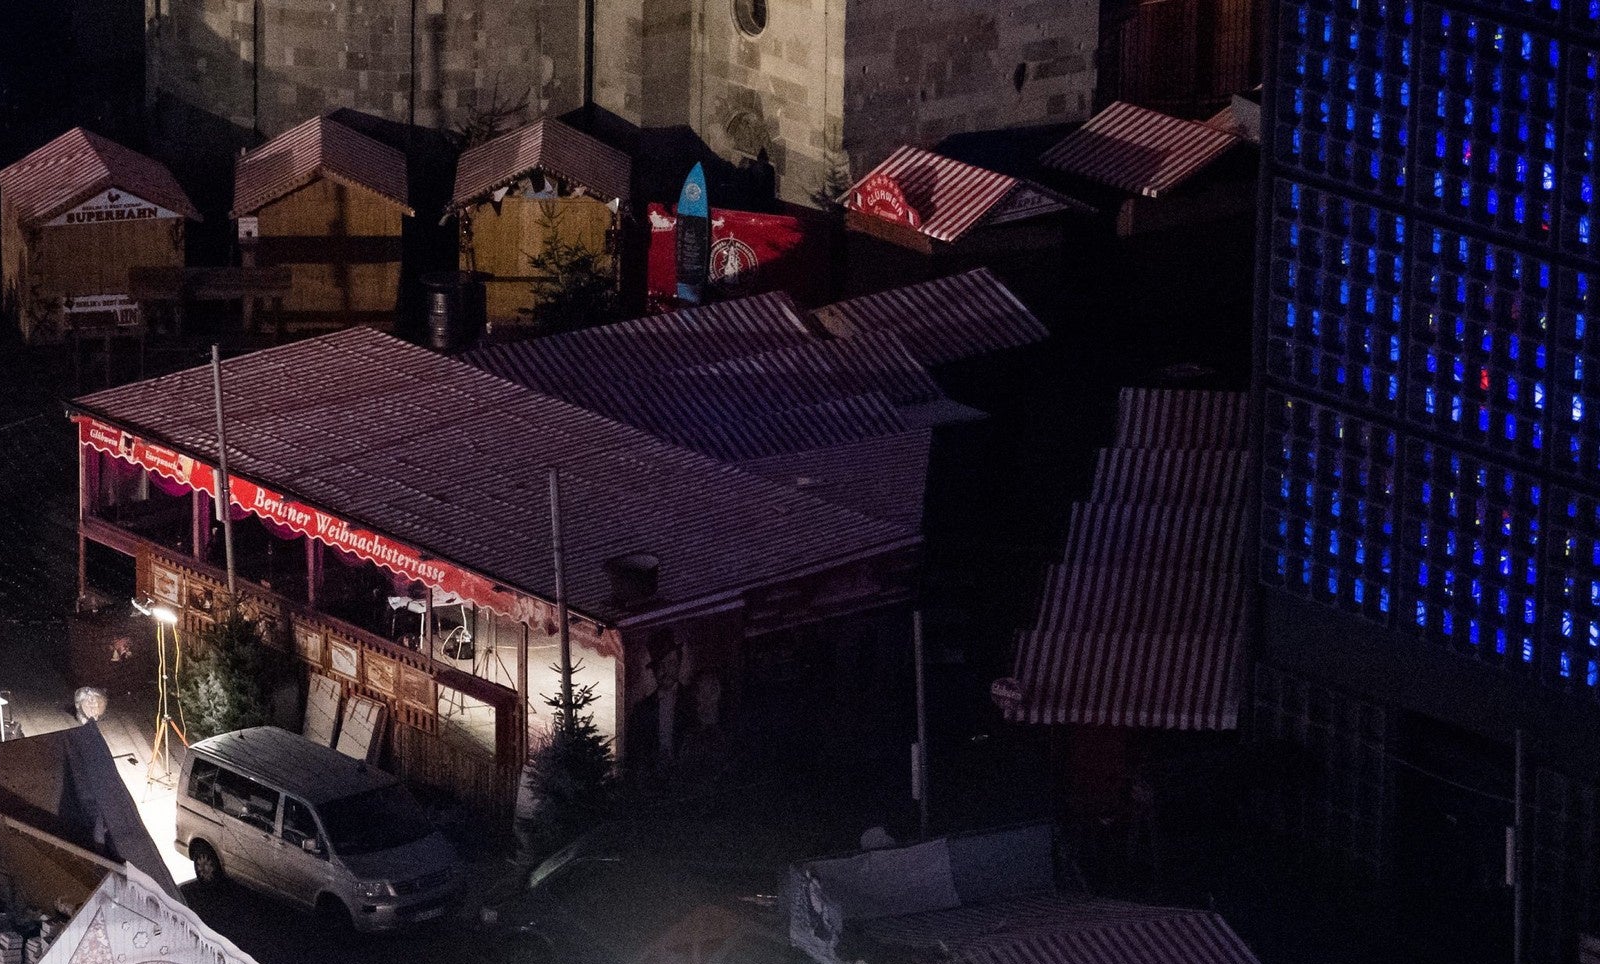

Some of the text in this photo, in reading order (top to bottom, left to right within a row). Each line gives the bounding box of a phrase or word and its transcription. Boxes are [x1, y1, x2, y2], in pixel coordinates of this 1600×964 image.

[66, 207, 158, 224] SUPERHAHN
[867, 189, 904, 216] GLÜHWEIN
[254, 486, 446, 583] Berliner Weihnachtsterrasse
